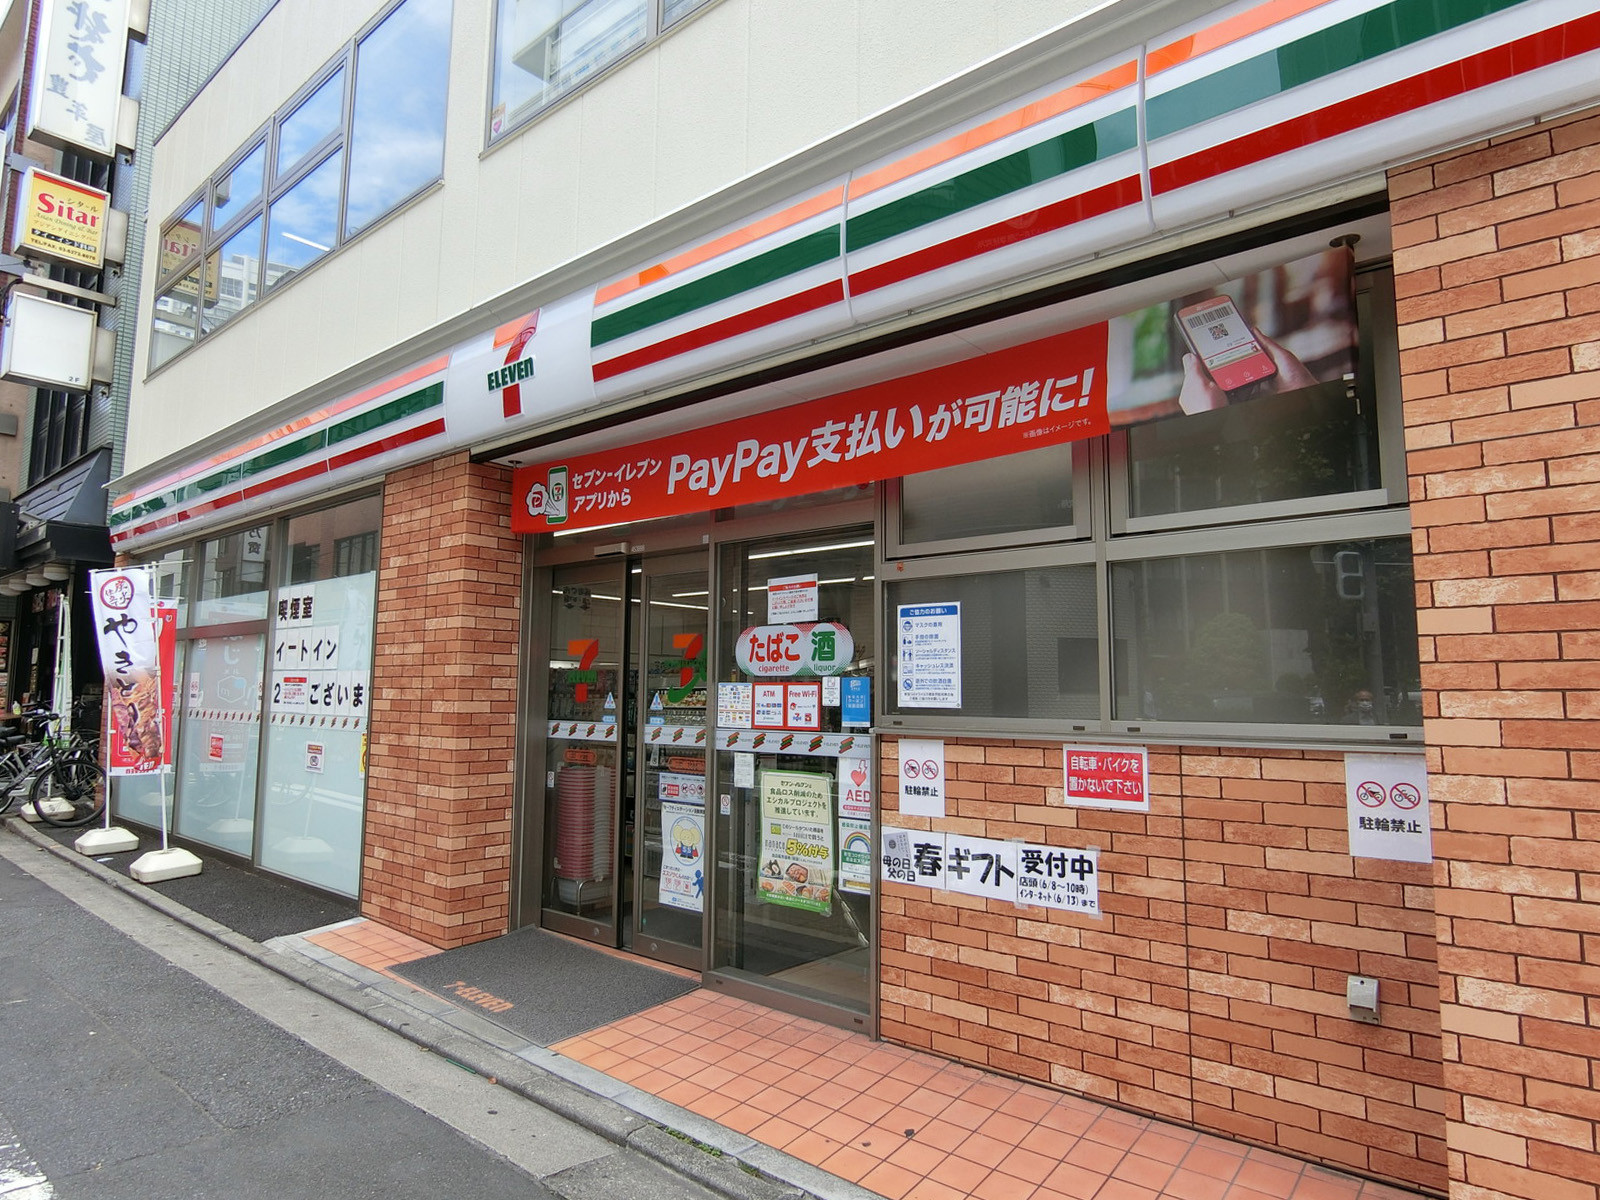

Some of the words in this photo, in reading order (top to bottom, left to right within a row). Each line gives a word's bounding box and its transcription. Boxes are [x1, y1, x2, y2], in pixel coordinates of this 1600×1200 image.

[37, 193, 100, 227] Sitar
[573, 487, 632, 513] アプリから
[278, 596, 313, 621] 喫煙室
[276, 639, 336, 662] イートイン
[749, 631, 801, 663] たばこ
[812, 631, 836, 662] 酒
[103, 613, 139, 729] やきとり
[758, 664, 790, 674] cigarette
[813, 664, 837, 672] liquor
[309, 682, 364, 708] ございま
[763, 690, 776, 698] ATM
[789, 690, 801, 698] Free
[1071, 755, 1139, 773] 自転車・バイクを
[770, 787, 823, 799] 食品ロス削減のため
[905, 785, 938, 797] 駐輪禁止
[1069, 776, 1142, 795] 置かないで下さい
[766, 796, 827, 810] エシカルプロジェクトを
[845, 789, 871, 803] AED
[1358, 816, 1422, 834] 駐輪禁止
[786, 837, 829, 859] 5%付与
[882, 855, 911, 870] 母の日
[887, 867, 916, 882] 父の日
